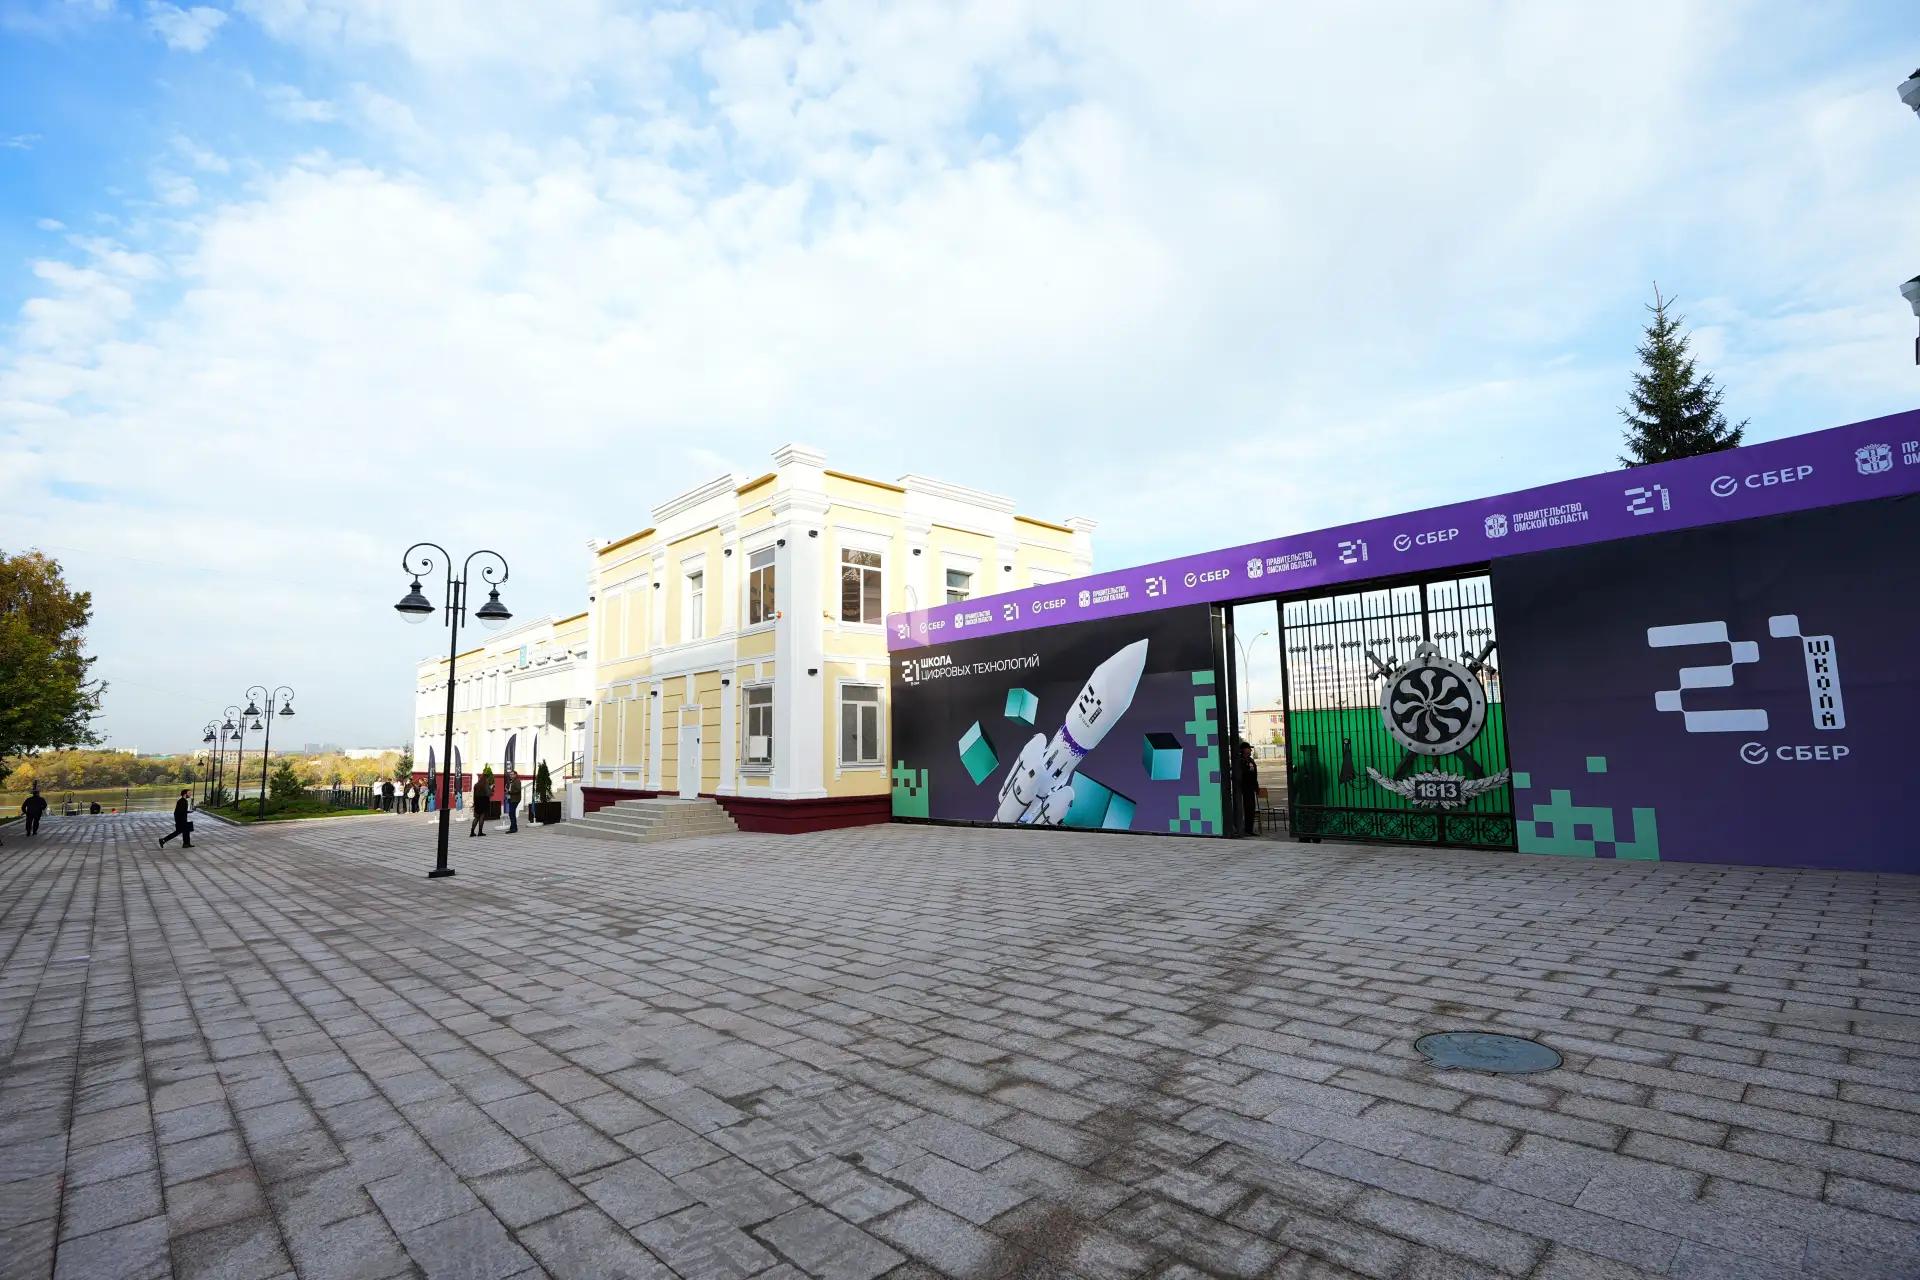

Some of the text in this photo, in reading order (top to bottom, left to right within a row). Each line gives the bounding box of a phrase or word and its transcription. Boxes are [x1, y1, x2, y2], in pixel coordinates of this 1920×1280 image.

[1744, 464, 1814, 489] СБЕР
[1624, 484, 1671, 516] 21
[1513, 502, 1582, 523] ПРАВИТЕЛЬСТВО
[1514, 511, 1589, 533] ОМСКОЙ ОБЛАСТИ
[1415, 528, 1459, 546] СБЕР
[1338, 539, 1368, 564] 21
[1145, 576, 1167, 597] 21
[1200, 569, 1230, 583] СБЕР
[1043, 598, 1067, 610] СБЕР
[928, 620, 946, 632] СБЕР
[920, 654, 952, 669] ШКОЛА
[920, 653, 1040, 681] ЦИФРОВЫХ ТЕХНОЛОГИЙ
[1647, 614, 1846, 733] 21
[1807, 640, 1836, 727] ШКОЛА
[1776, 745, 1850, 761] СБЕР
[1417, 783, 1459, 799] 1813
